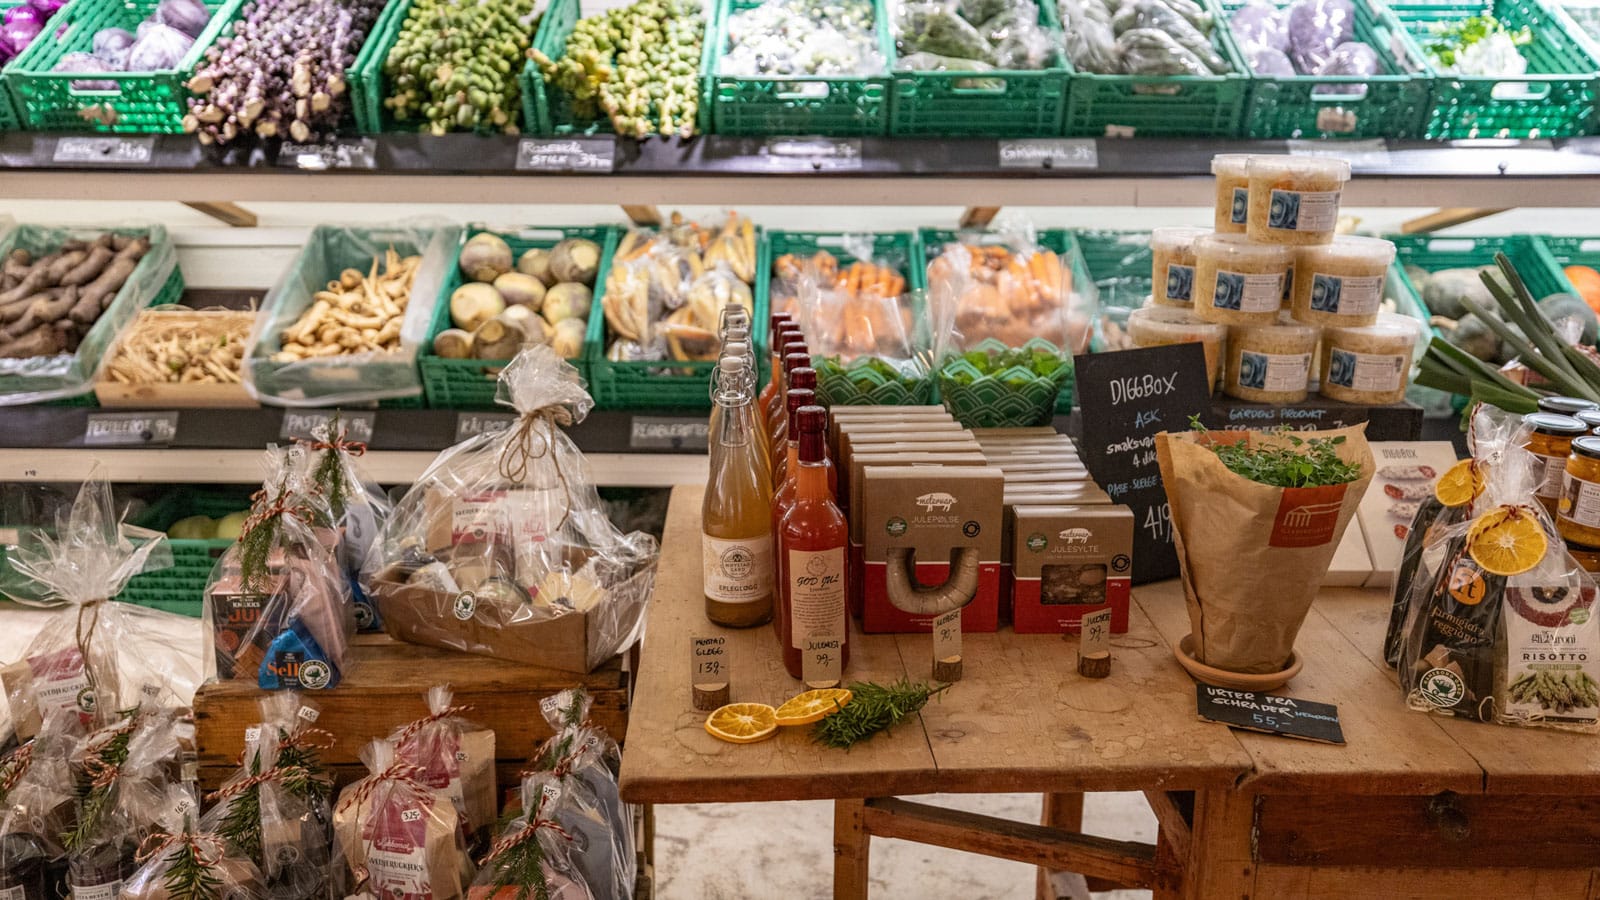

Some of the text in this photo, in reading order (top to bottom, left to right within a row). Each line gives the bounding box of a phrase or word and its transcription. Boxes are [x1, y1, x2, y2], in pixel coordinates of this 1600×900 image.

[911, 515, 960, 524] JULEPØLSE
[1051, 545, 1099, 553] JULESYLTE
[1522, 652, 1588, 661] RISOTTO
[1206, 687, 1298, 708] URTER FRA
[1211, 697, 1295, 719] SCHRADER
[1252, 713, 1292, 729] 55,-
